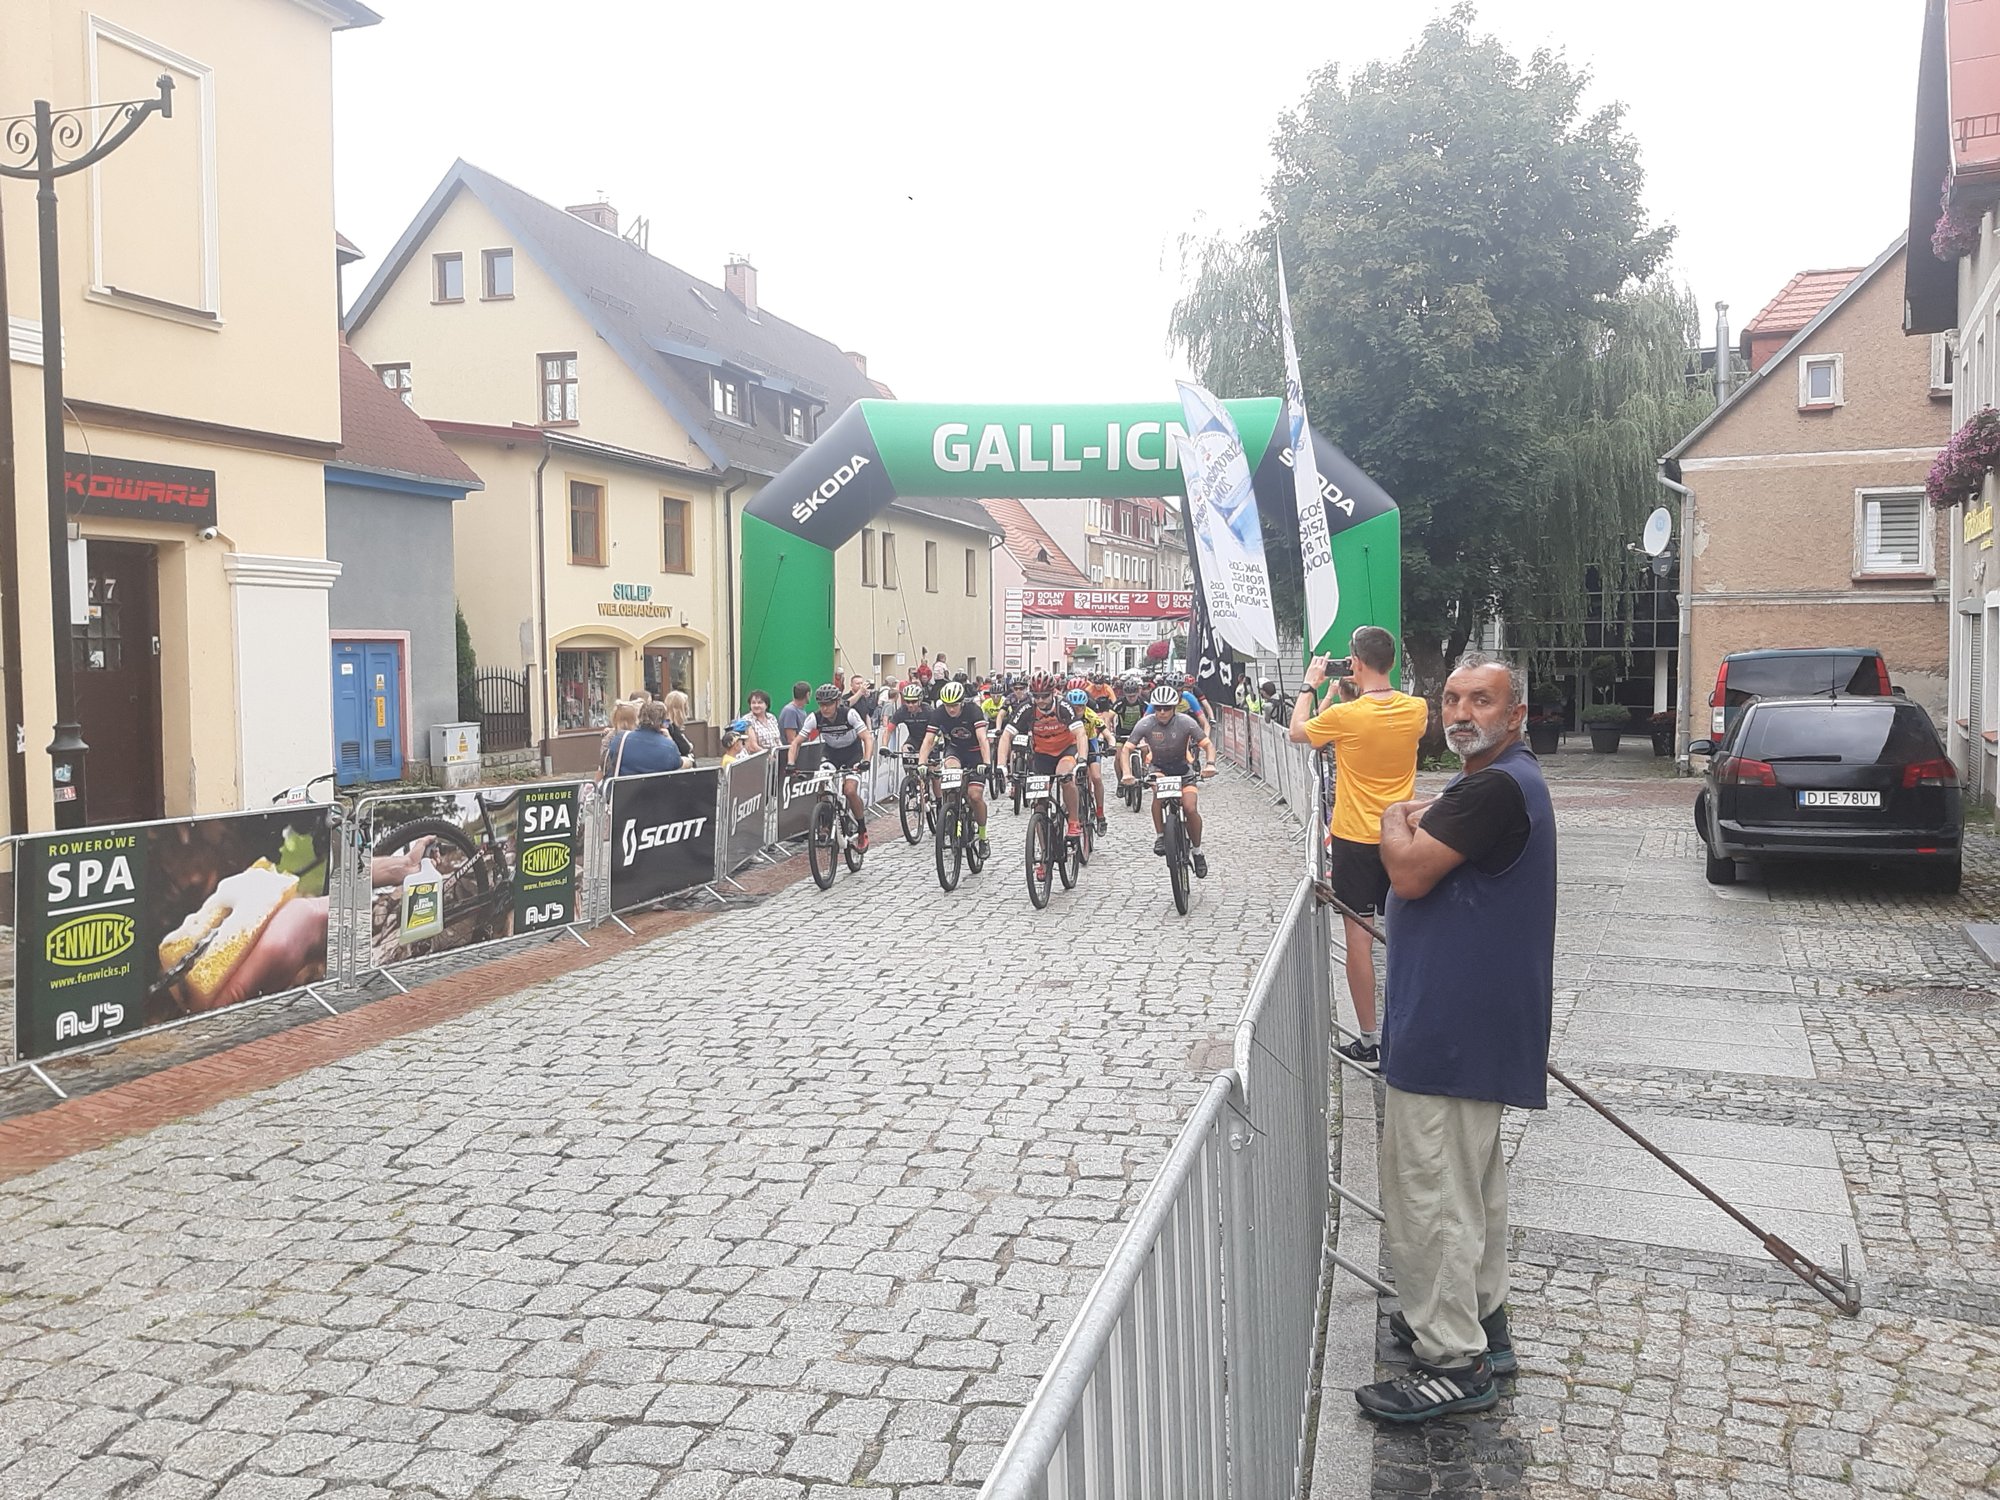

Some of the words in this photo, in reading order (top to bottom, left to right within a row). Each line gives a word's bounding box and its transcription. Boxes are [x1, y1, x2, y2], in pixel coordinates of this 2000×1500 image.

[64, 471, 210, 508] KOWARY
[791, 454, 870, 524] ŠKODA
[613, 583, 652, 601] SKLEP
[1091, 592, 1130, 603] BIKE
[1091, 603, 1130, 611] maraton
[1091, 622, 1132, 633] KOWARY
[525, 791, 572, 802] ROWEROWE
[736, 793, 762, 823] SCOTT
[523, 804, 571, 833] SPA
[48, 836, 136, 856] ROWEROWE
[637, 817, 707, 850] SCOTT
[47, 855, 135, 902] SPA
[46, 915, 135, 962] FENWICK'S
[50, 962, 130, 990] www.fenwicks.pl
[56, 1001, 125, 1040] AJ'S
